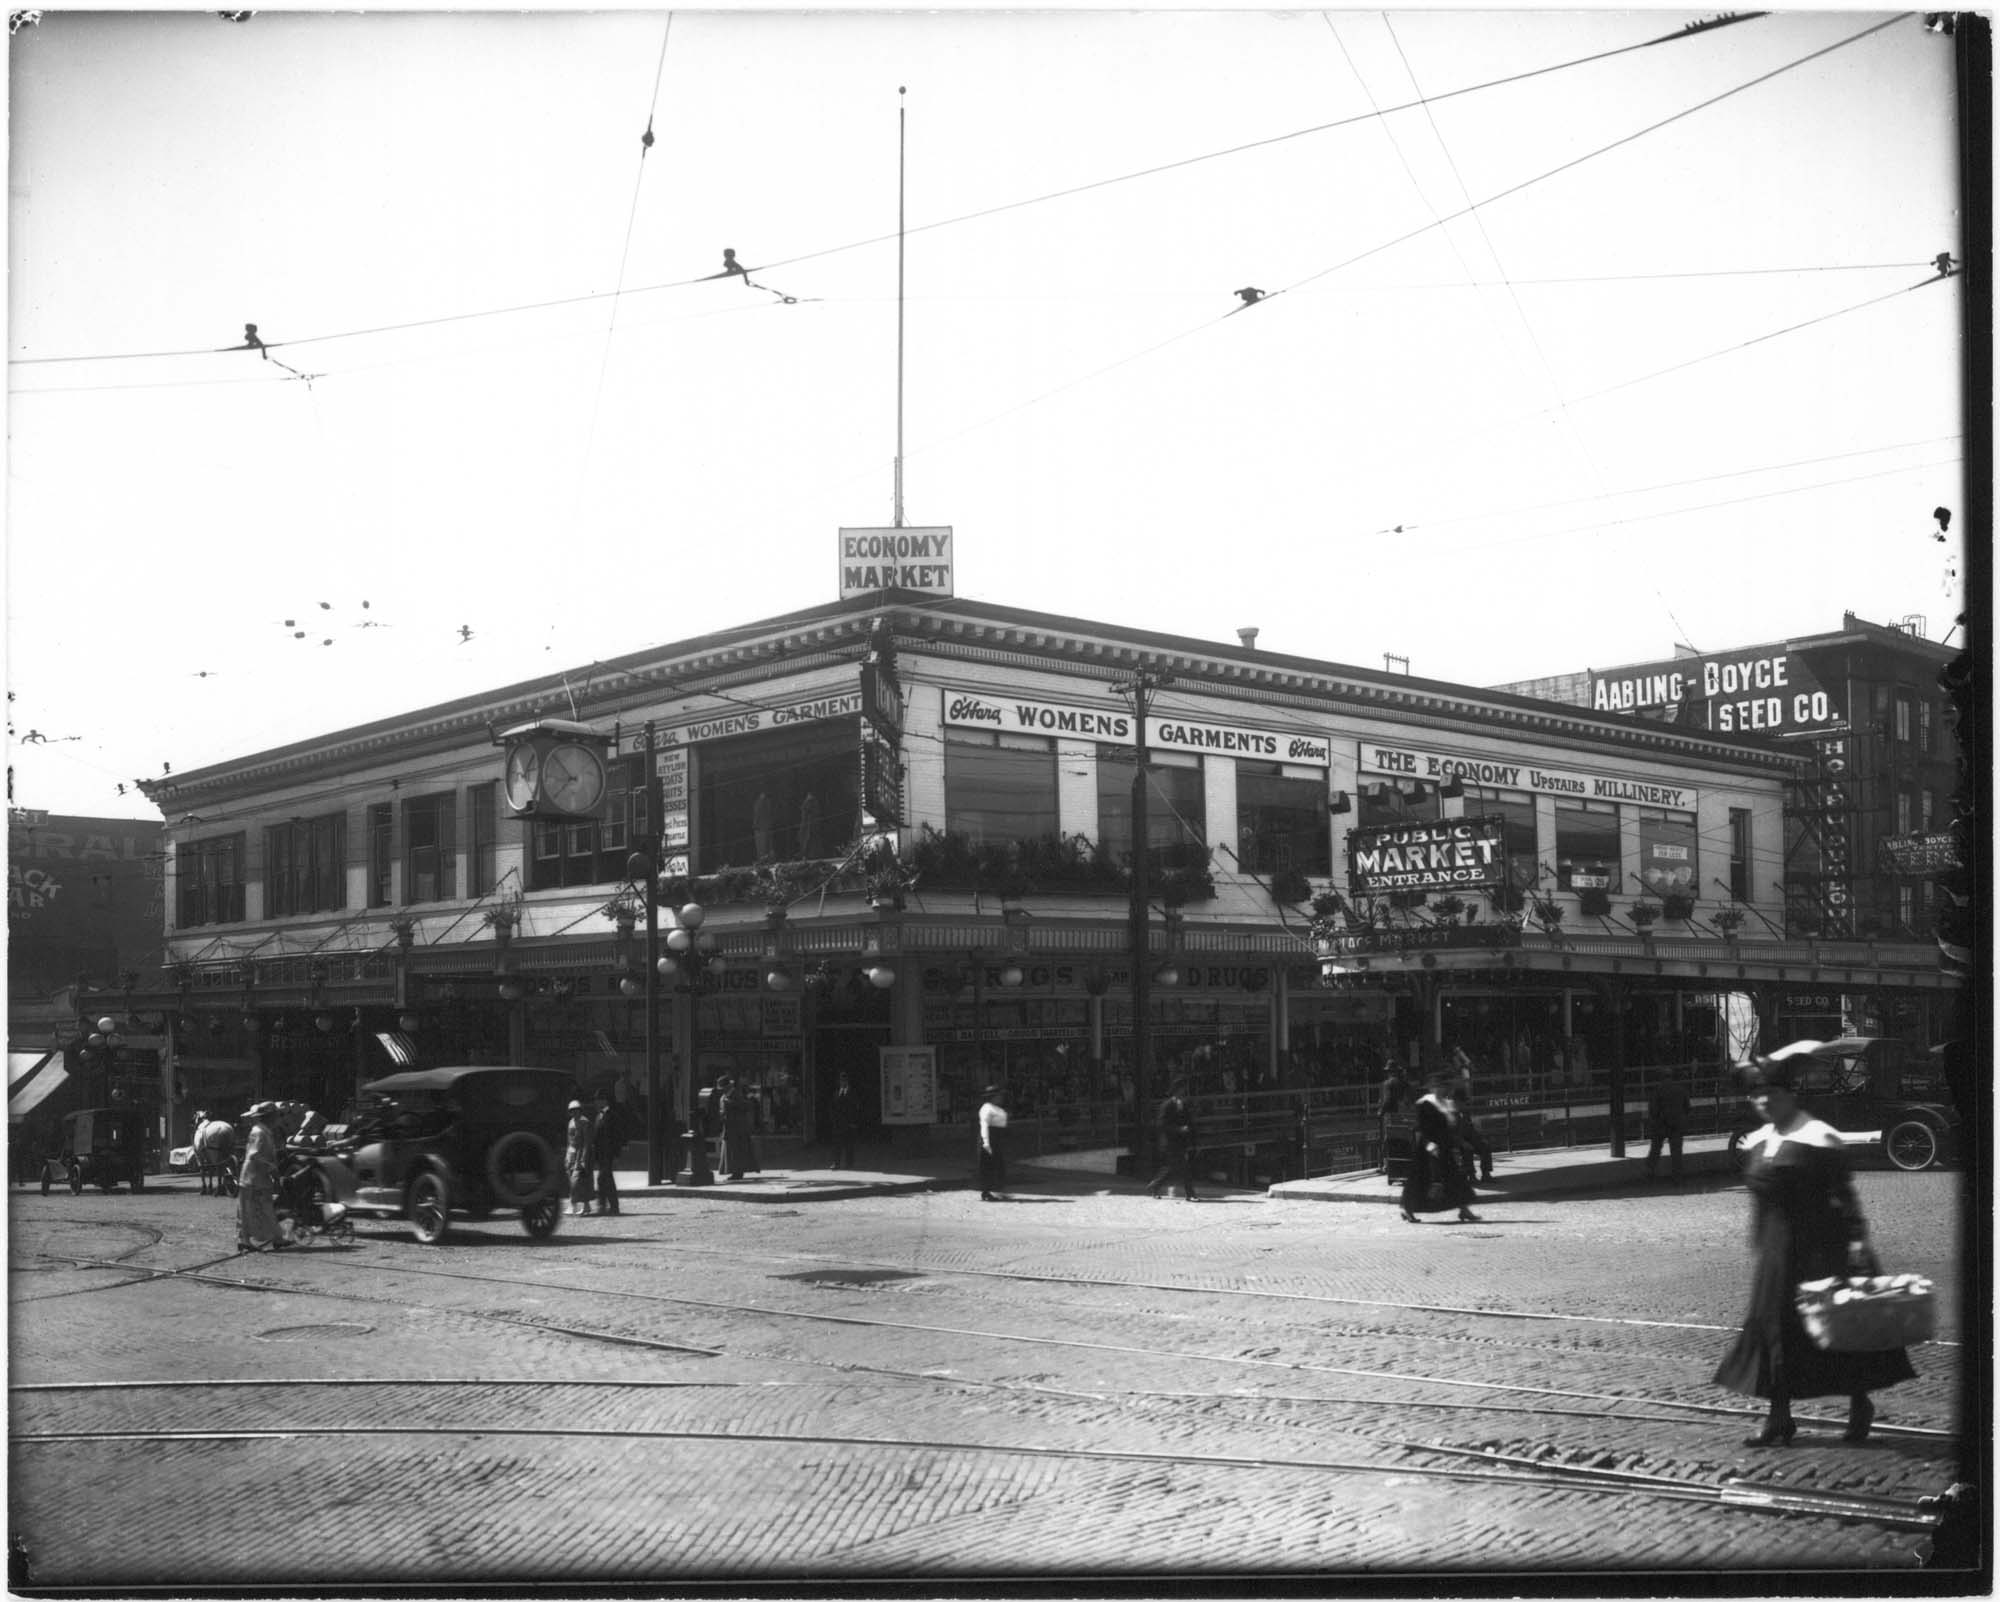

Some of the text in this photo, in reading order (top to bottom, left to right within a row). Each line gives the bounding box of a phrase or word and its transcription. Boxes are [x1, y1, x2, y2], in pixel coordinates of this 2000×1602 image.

[844, 535, 949, 559] ECONOMY
[844, 565, 950, 589] MARKET
[633, 731, 679, 751] Oara
[688, 713, 760, 741] WOMEN'S
[773, 695, 861, 725] GARMENT
[1720, 691, 1839, 732] SEED CO.
[950, 695, 1327, 762] O'Hara WOMENS GARMENTS O'Hara
[1376, 749, 1416, 773] THE
[1427, 755, 1520, 786] ECONOMY
[1594, 779, 1686, 807] MILLINERY.
[664, 787, 682, 799] UITS
[664, 801, 686, 813] ESSES
[1376, 825, 1472, 846] PUBLIC
[1356, 838, 1498, 875] MARKET
[1367, 868, 1485, 887] ENTRANCE
[699, 968, 761, 991] RGS
[963, 967, 1073, 987] DRGS
